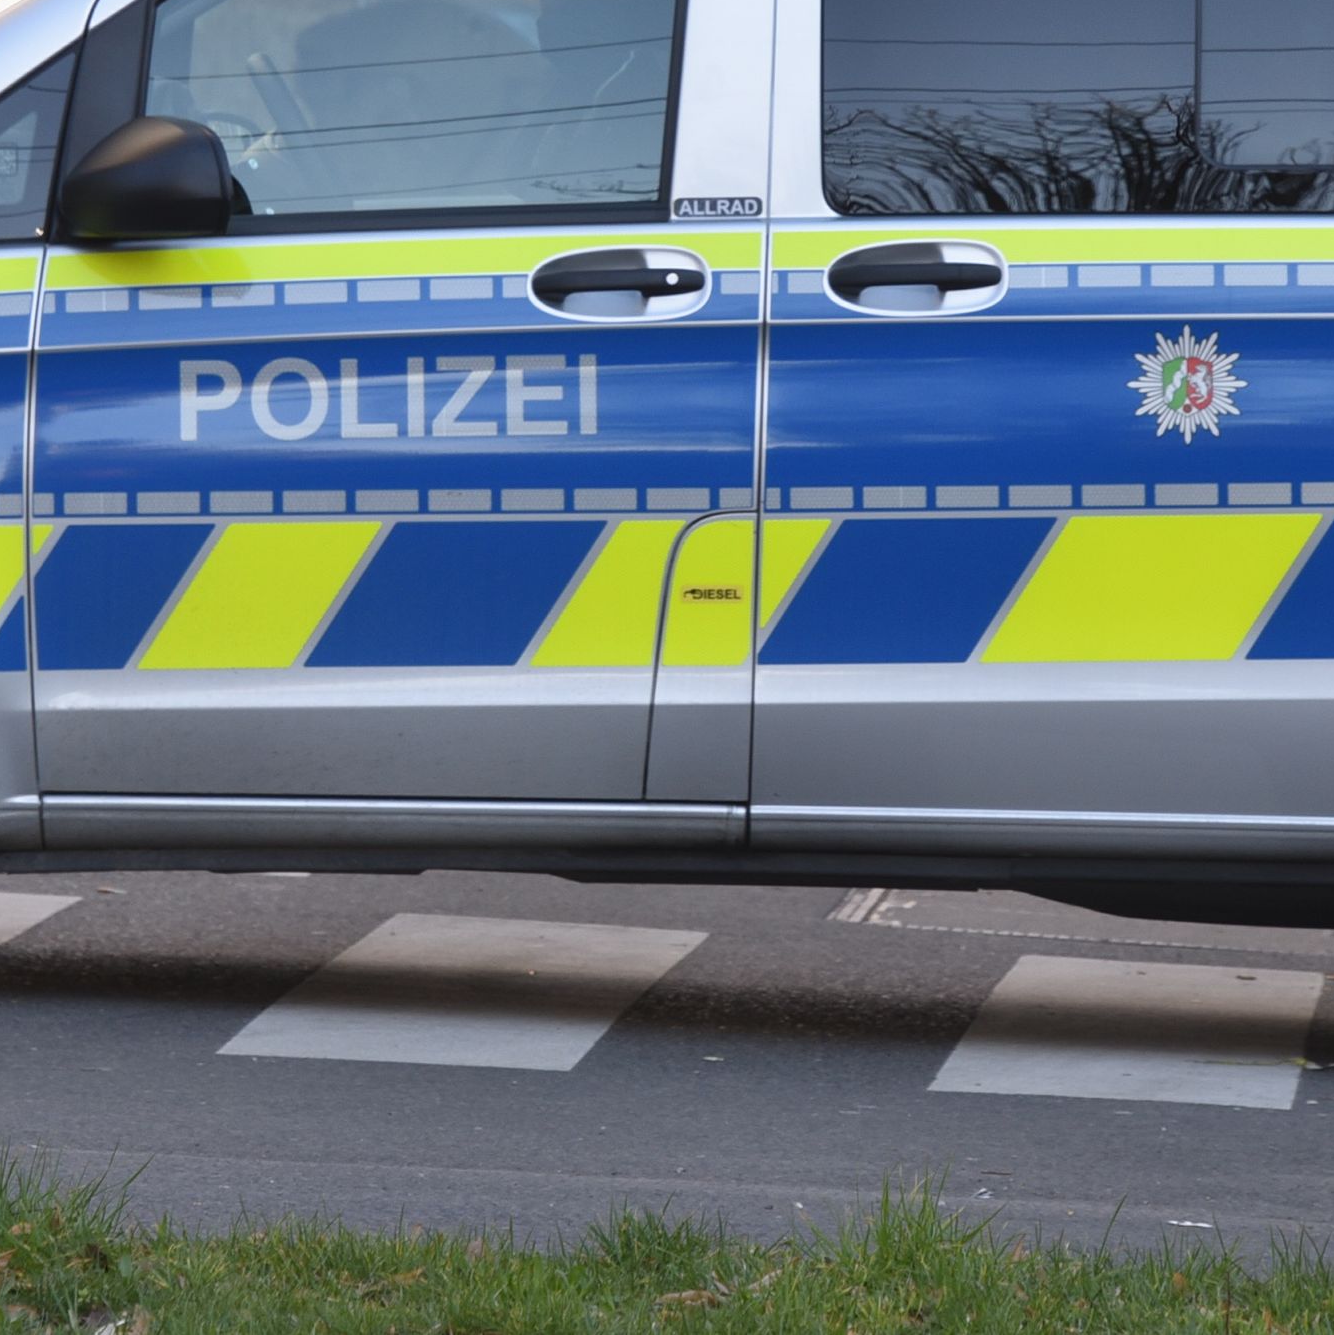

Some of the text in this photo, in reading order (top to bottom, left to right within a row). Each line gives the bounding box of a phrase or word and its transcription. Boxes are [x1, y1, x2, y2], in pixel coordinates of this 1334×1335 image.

[679, 199, 758, 215] ALLRAD
[179, 354, 597, 442] POLIZEI
[693, 588, 741, 600] DIESEL
